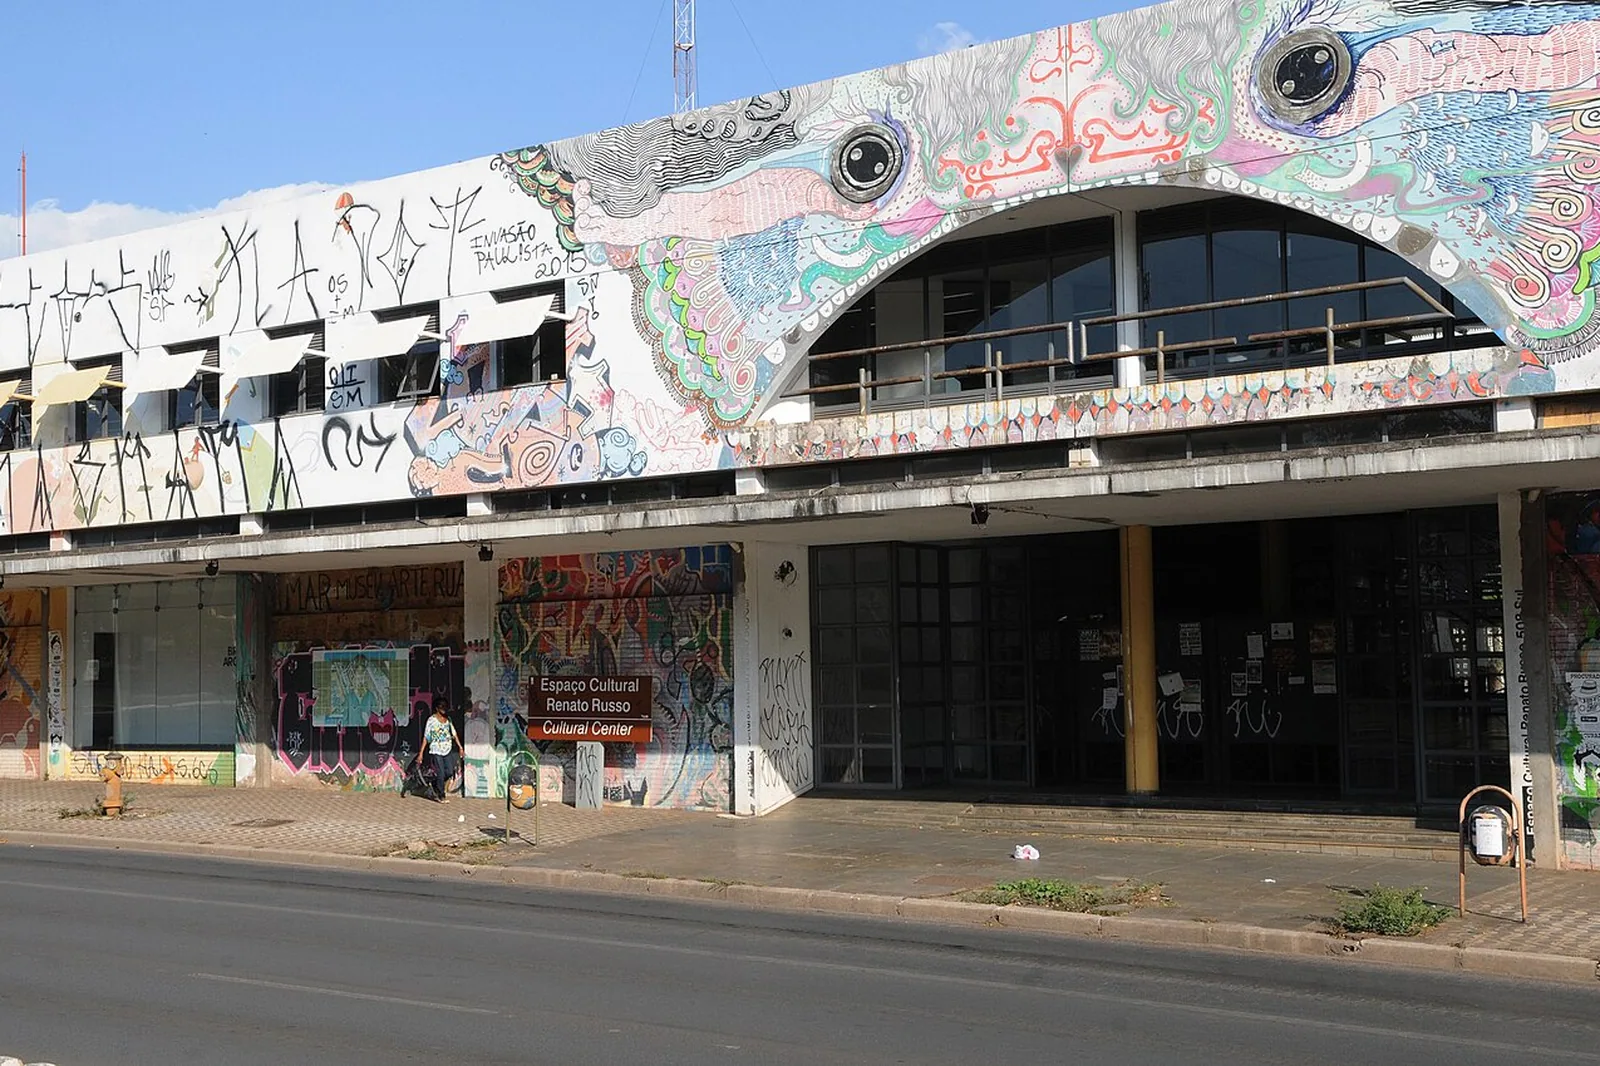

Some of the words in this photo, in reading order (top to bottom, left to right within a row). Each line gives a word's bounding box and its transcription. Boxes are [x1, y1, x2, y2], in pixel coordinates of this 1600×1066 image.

[470, 220, 536, 248] INVASÃO
[534, 251, 587, 279] 2015
[541, 677, 586, 695] Espaço
[589, 677, 639, 692] Cultural
[546, 697, 589, 711] Renato
[591, 698, 631, 712] Russo
[542, 720, 588, 735] Cultural
[591, 720, 633, 735] Center
